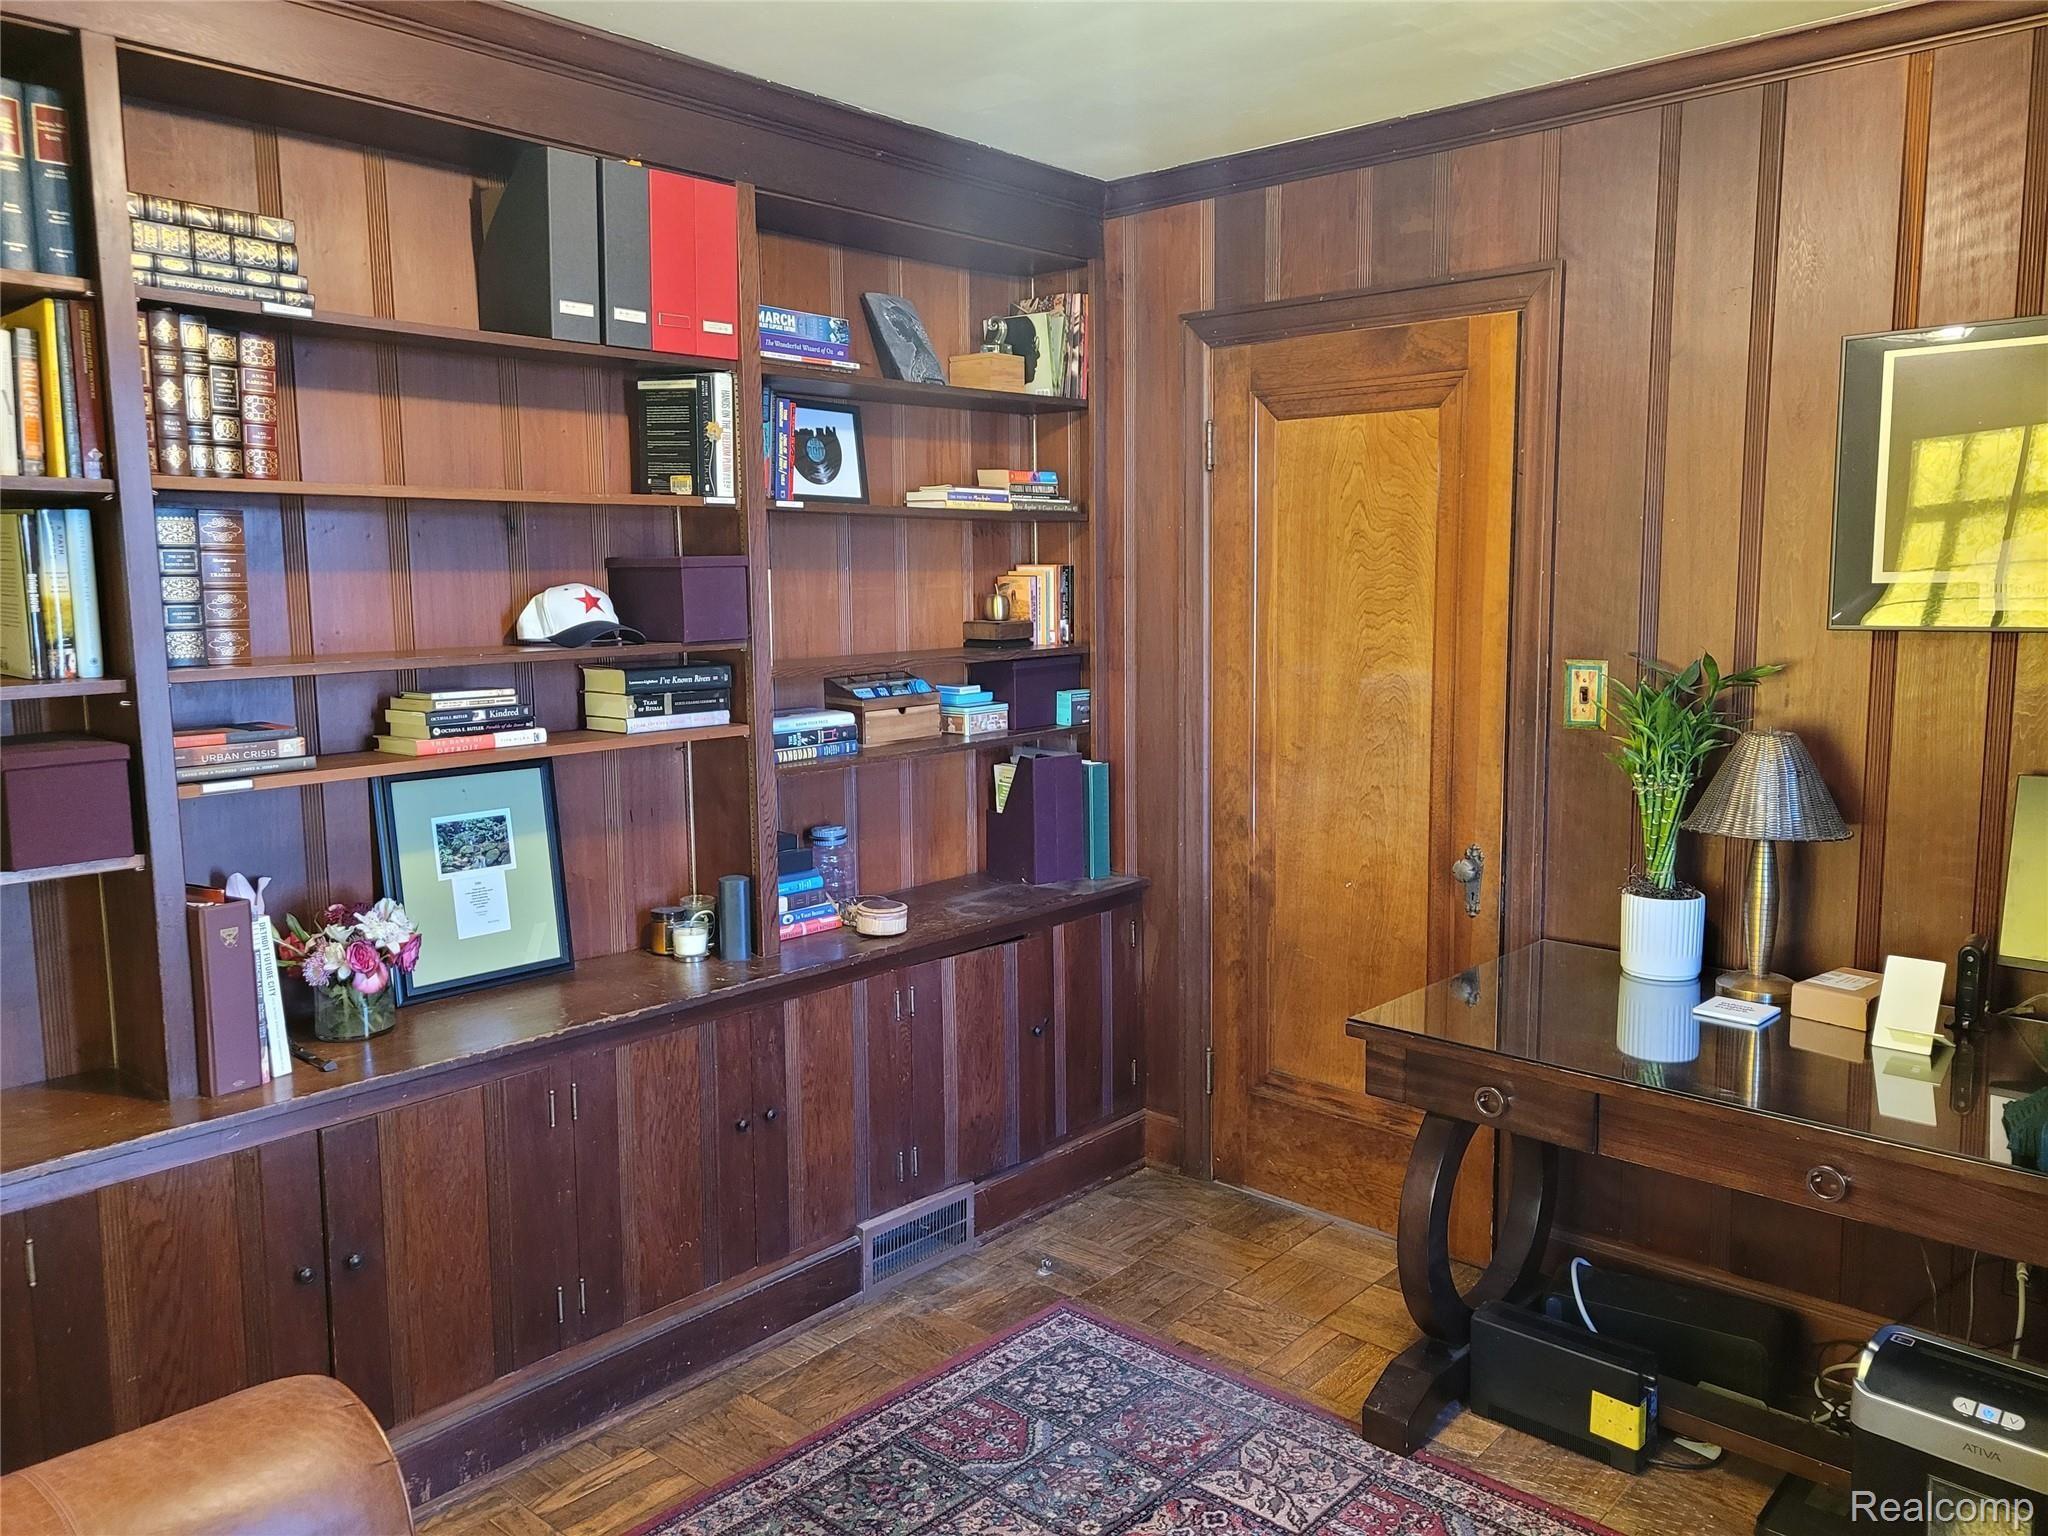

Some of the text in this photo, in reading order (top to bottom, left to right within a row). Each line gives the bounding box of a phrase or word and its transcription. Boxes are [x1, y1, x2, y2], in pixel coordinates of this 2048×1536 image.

[178, 281, 203, 292] STOOPS
[203, 284, 213, 292] TO
[214, 285, 246, 297] CONQUER
[758, 310, 796, 328] MARCH
[765, 338, 774, 347] The
[774, 340, 802, 351] Wonderful
[802, 343, 820, 353] Wizard
[820, 346, 827, 355] of
[22, 361, 40, 418] COLLAPSE
[659, 674, 711, 685] I've Known Rivers
[489, 707, 519, 718] Kindred
[200, 748, 277, 763] URBAN CRISIS
[436, 745, 480, 754] DETROIT
[777, 747, 817, 763] VANGUARD
[259, 921, 270, 951] DETROIT
[263, 952, 275, 981] FUTURE
[267, 980, 277, 997] CITY
[1961, 1442, 2002, 1462] ATIVA
